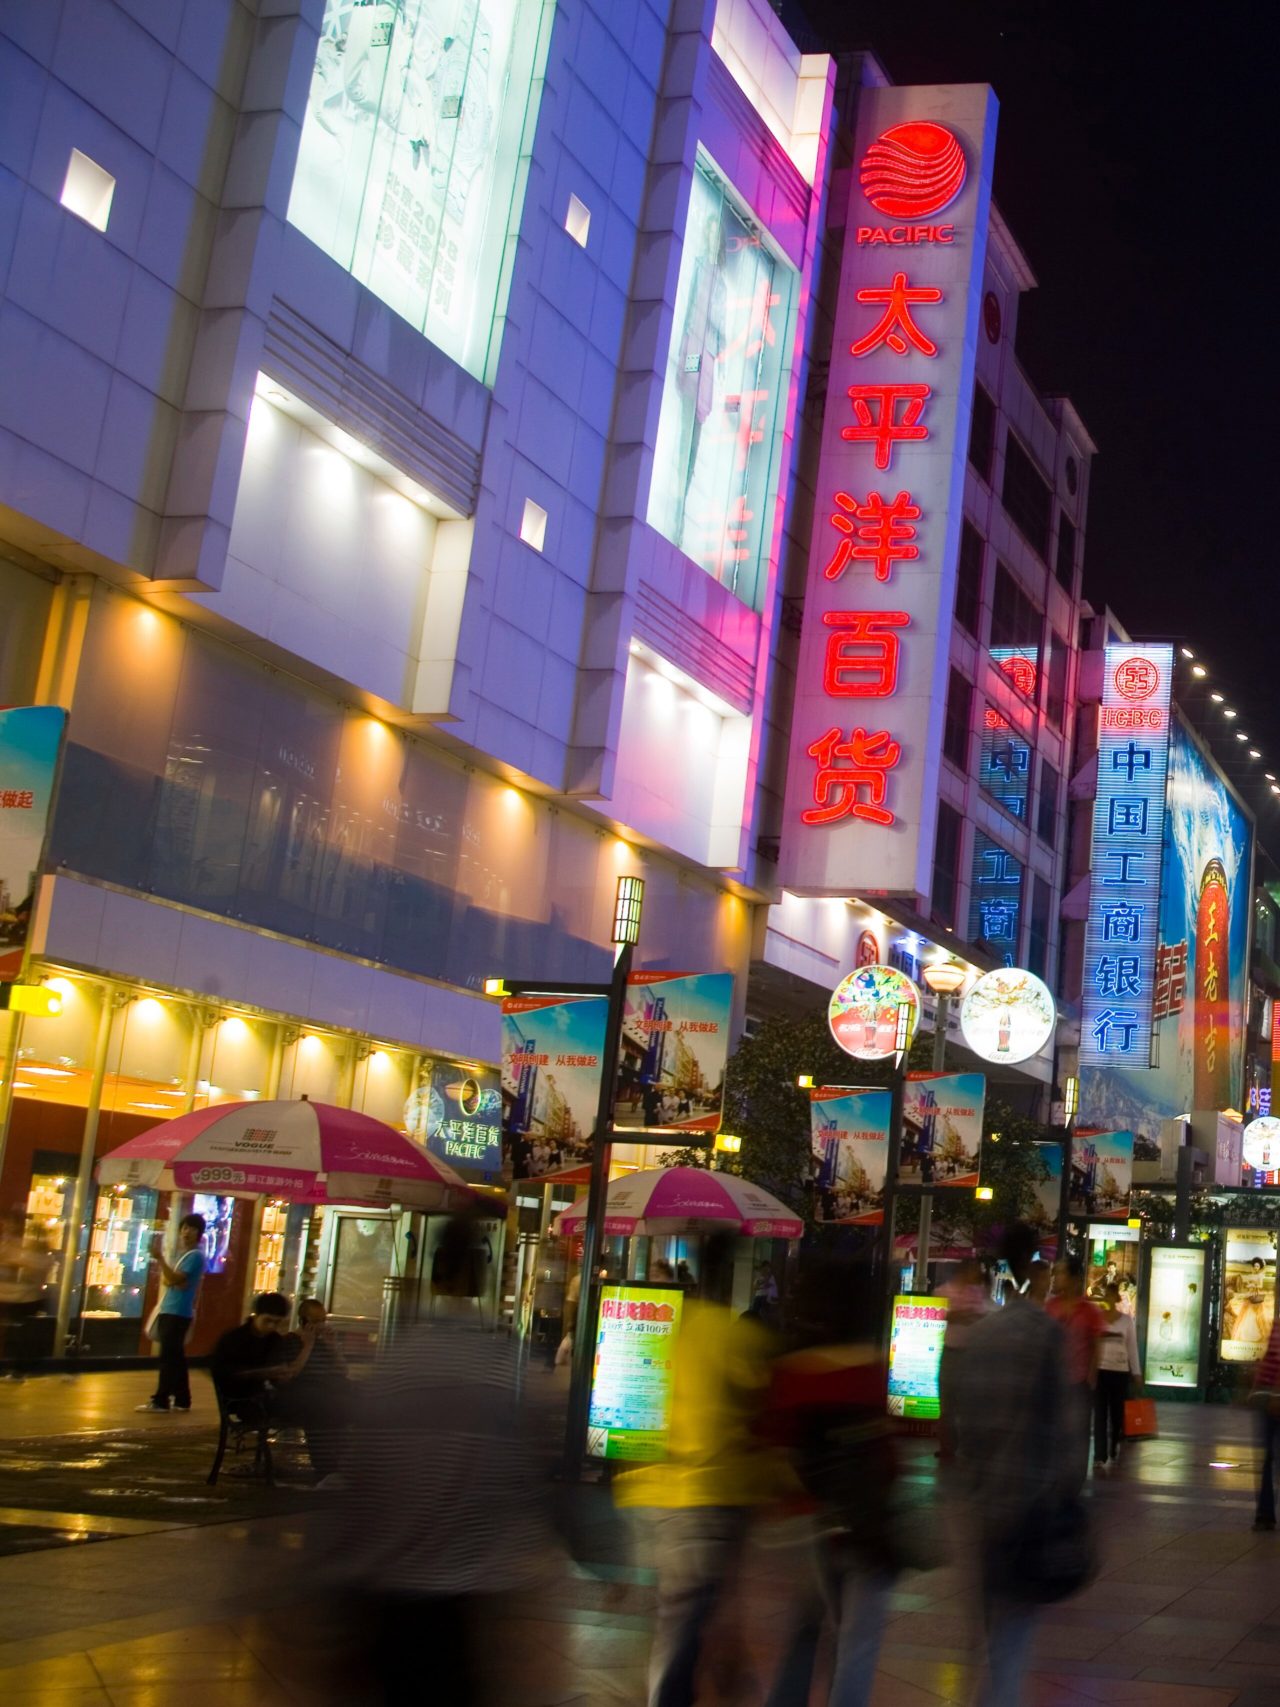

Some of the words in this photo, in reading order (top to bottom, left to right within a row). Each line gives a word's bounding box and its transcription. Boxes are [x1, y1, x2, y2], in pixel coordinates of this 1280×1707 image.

[857, 224, 954, 245] PACIFIC
[803, 272, 943, 826] 太平洋百货
[1103, 707, 1162, 728] ICBC
[1094, 739, 1152, 1054] 中国工商银行
[1204, 902, 1219, 1074] 王老吉
[634, 1019, 673, 1032] 文明创建
[679, 1020, 719, 1033] 从我做起
[509, 1053, 549, 1066] 文明创建
[555, 1054, 598, 1067] 从我做起
[235, 1141, 274, 1149] VOGUE
[445, 1141, 486, 1159] PACIFIC
